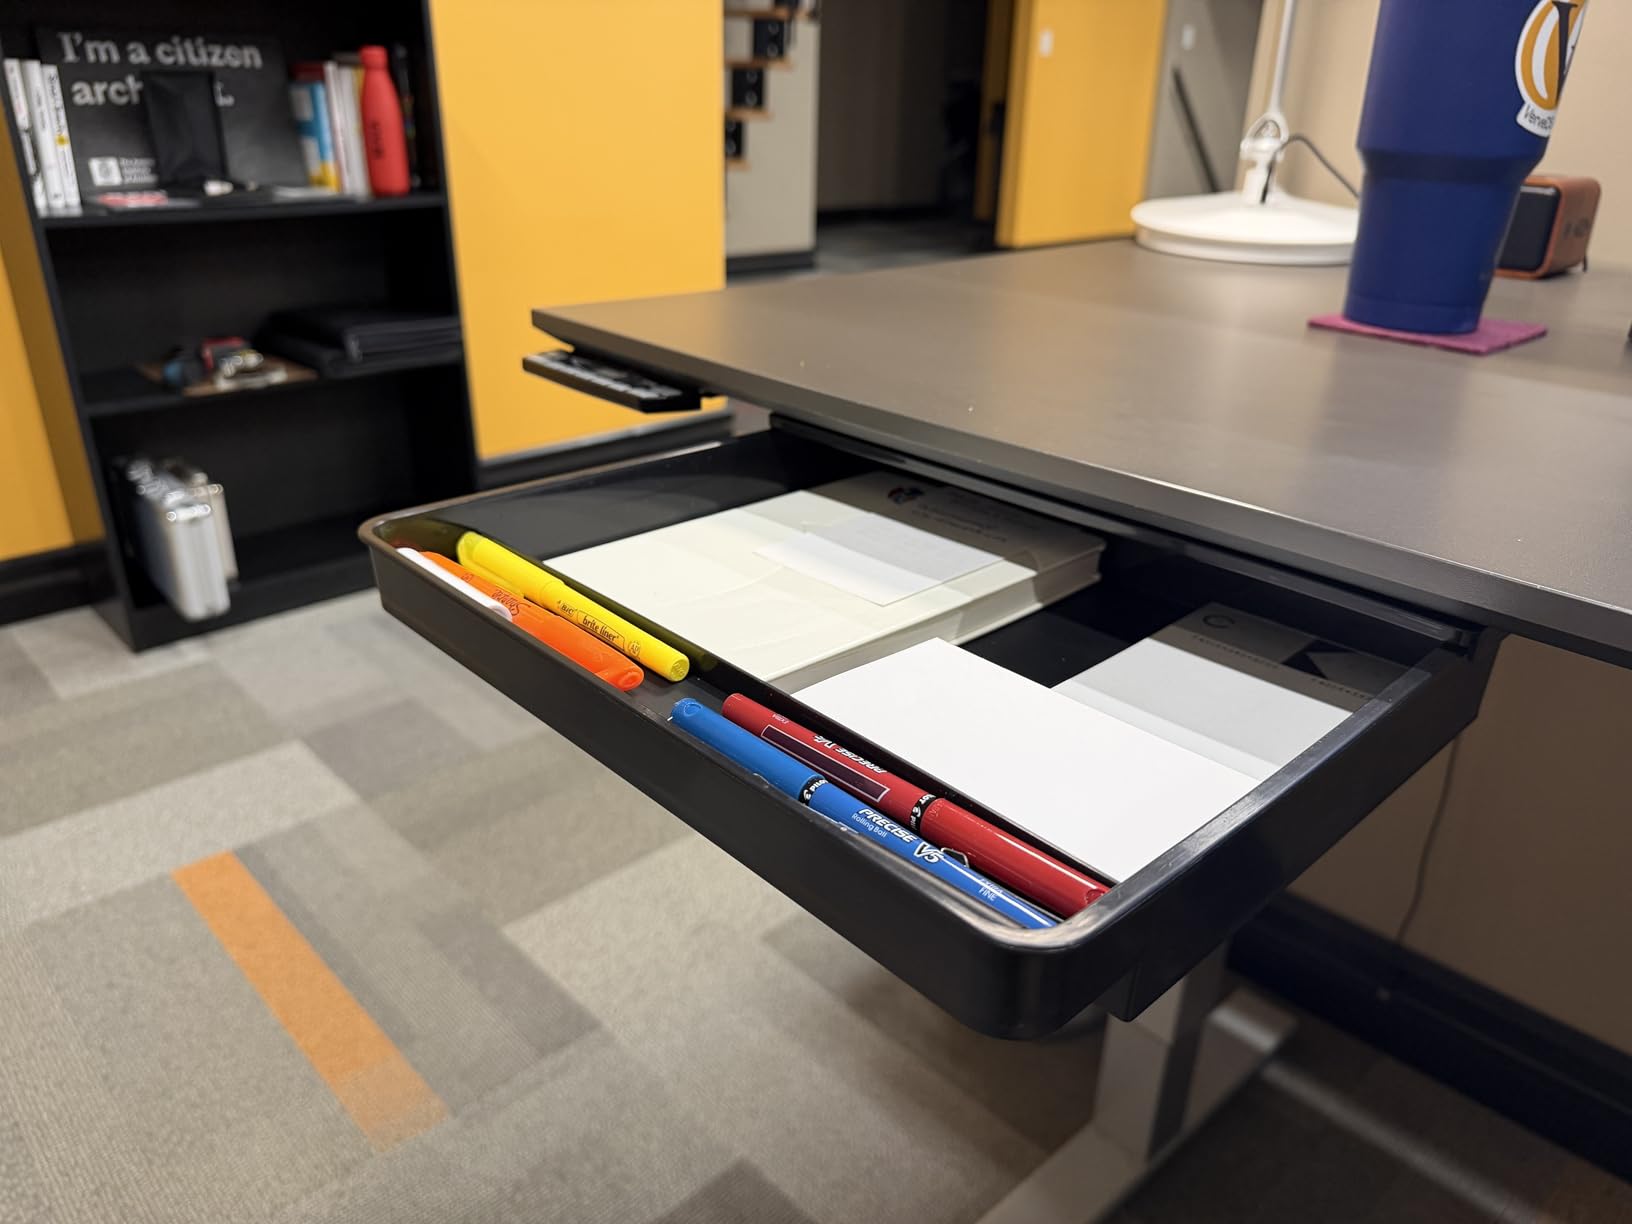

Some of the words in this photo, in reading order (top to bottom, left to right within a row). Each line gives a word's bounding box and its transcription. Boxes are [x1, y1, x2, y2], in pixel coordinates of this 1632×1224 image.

[59, 32, 121, 64] I'm
[126, 41, 152, 65] a
[155, 36, 264, 69] citizen
[582, 615, 600, 632] brite
[834, 746, 888, 774] PRECISE
[851, 812, 875, 832] Rolling
[873, 825, 888, 838] Ball
[857, 807, 917, 843] PRECISE
[912, 840, 944, 865] V5
[978, 886, 999, 902] FINE
